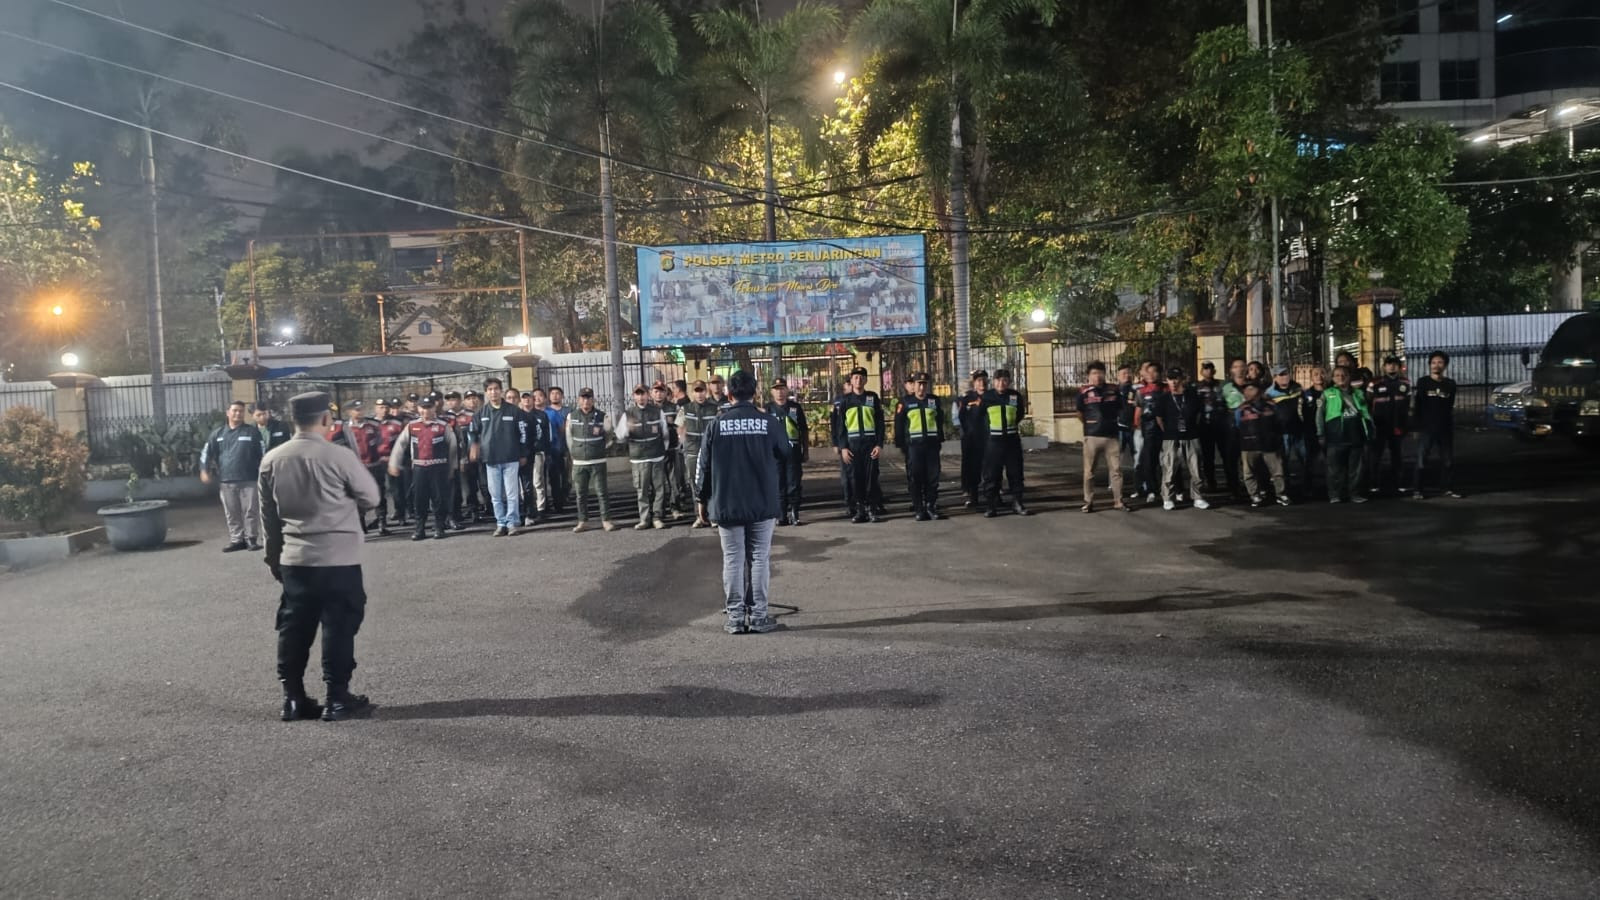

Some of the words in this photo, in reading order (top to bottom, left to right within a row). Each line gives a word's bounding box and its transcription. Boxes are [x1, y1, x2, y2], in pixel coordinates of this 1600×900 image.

[685, 254, 734, 267] POLSEK
[740, 252, 784, 265] METRO
[790, 248, 881, 261] PENJARINGAN
[1542, 386, 1585, 397] POLISI
[720, 418, 768, 431] RESERSE
